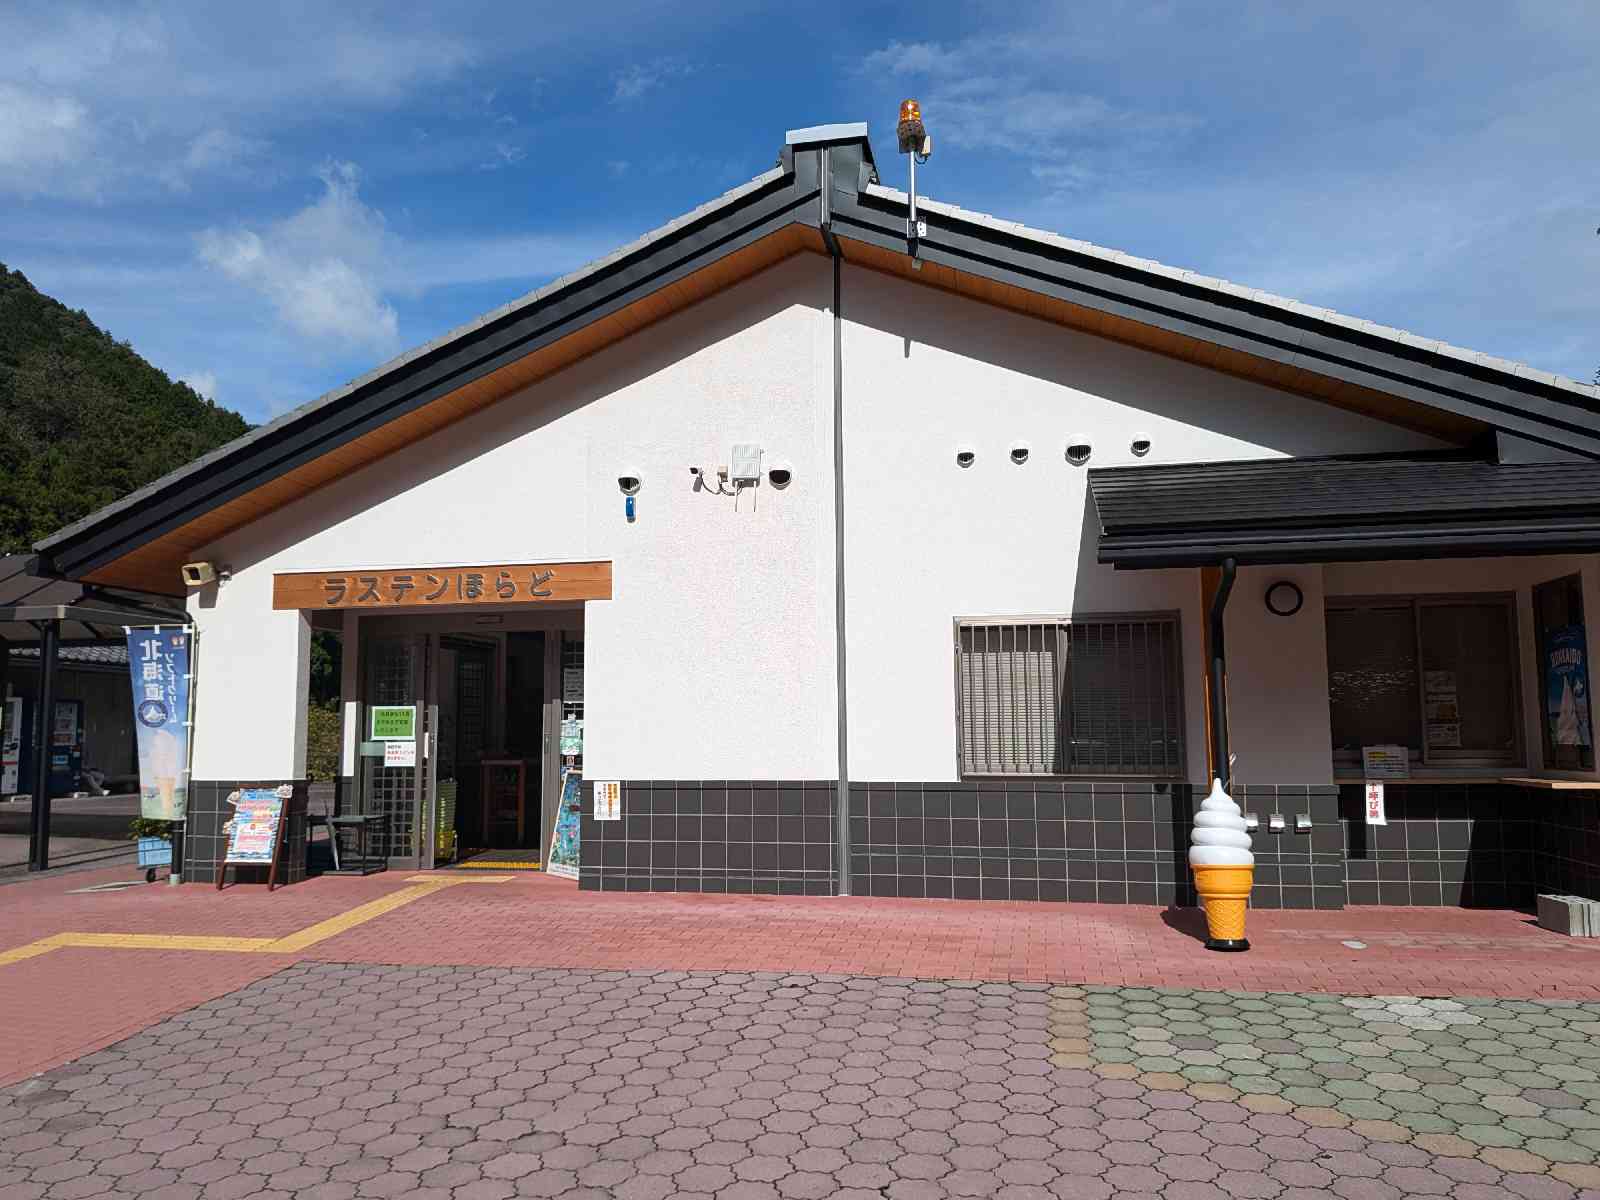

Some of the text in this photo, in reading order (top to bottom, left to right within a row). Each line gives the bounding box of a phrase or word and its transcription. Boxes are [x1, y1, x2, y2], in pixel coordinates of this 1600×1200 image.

[324, 569, 555, 604] ラステンほらど
